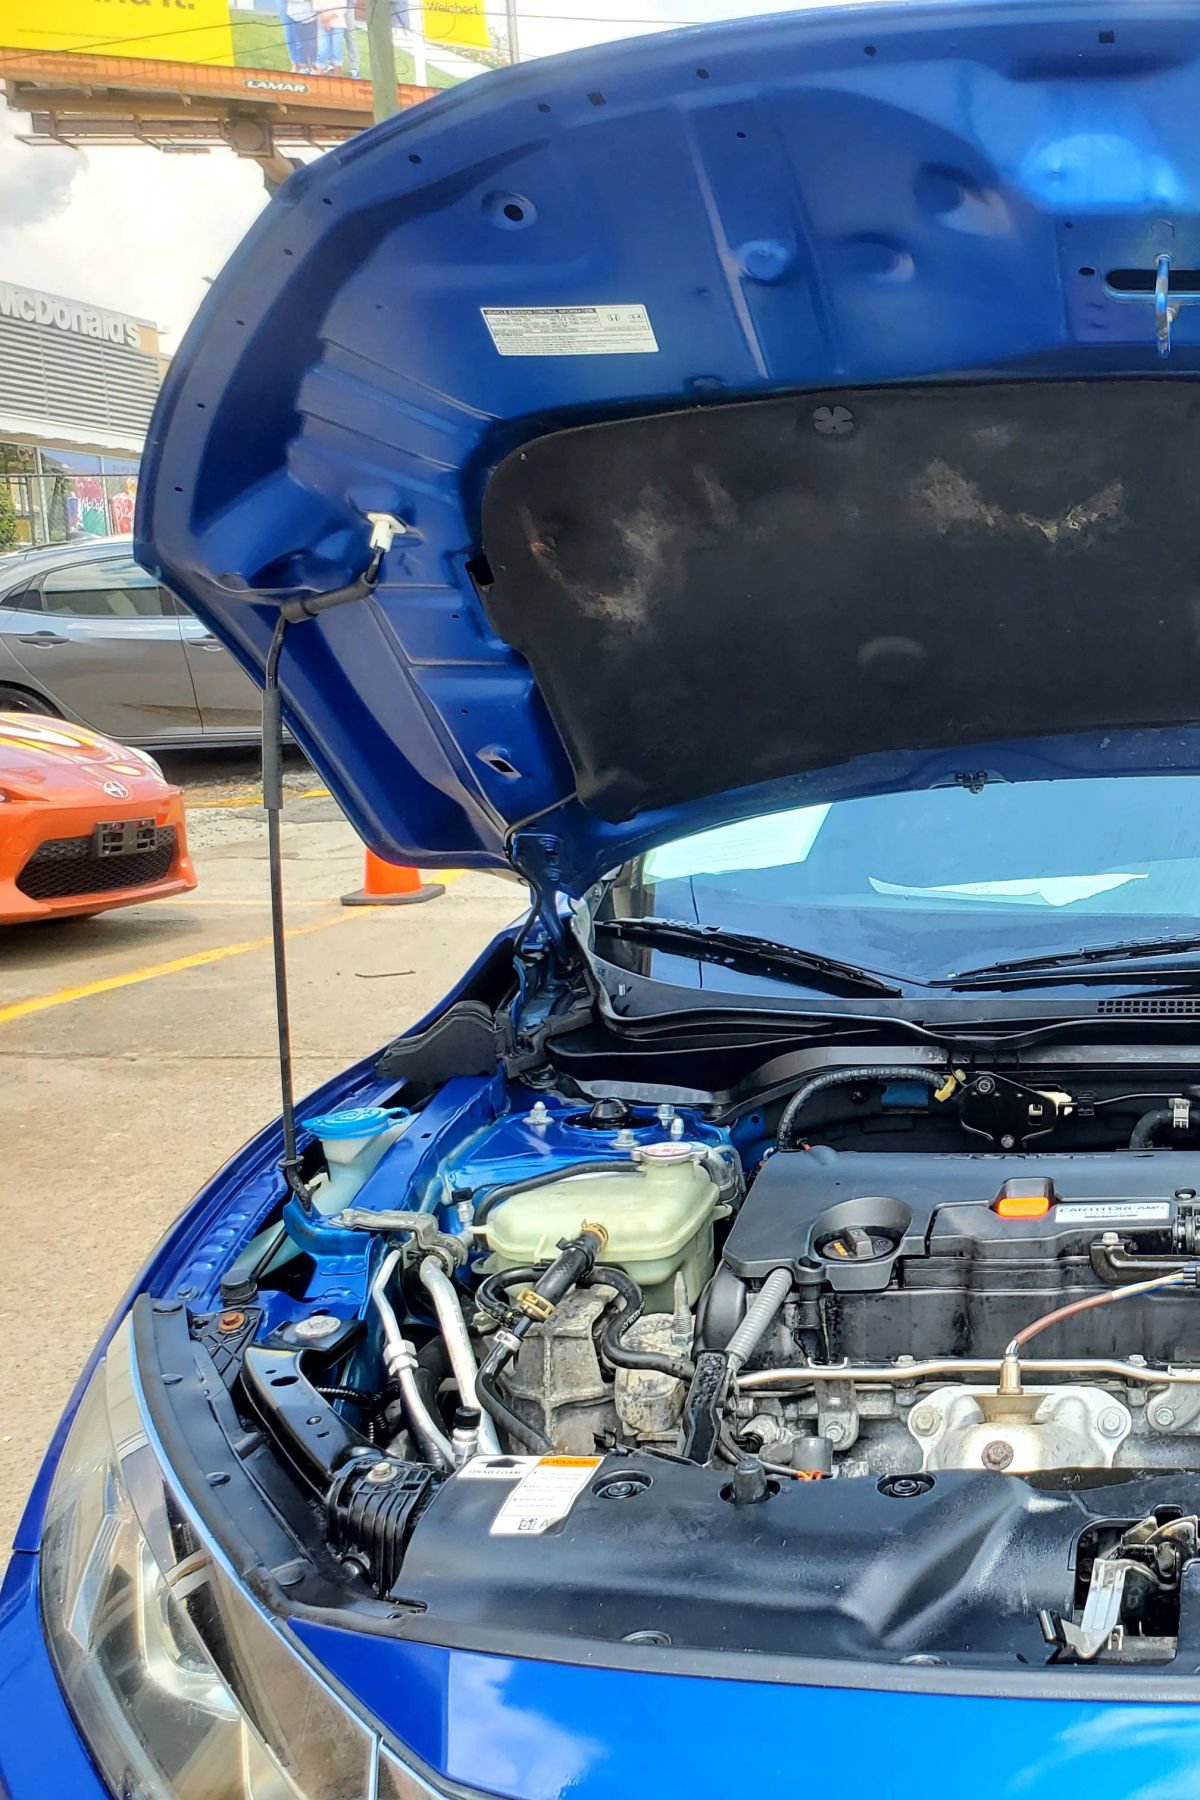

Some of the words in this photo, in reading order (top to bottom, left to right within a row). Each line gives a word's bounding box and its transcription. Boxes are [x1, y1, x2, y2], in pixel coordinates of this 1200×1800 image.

[426, 1, 480, 15] Weichert
[247, 80, 306, 93] LAMAR
[0, 284, 142, 349] McDonald's
